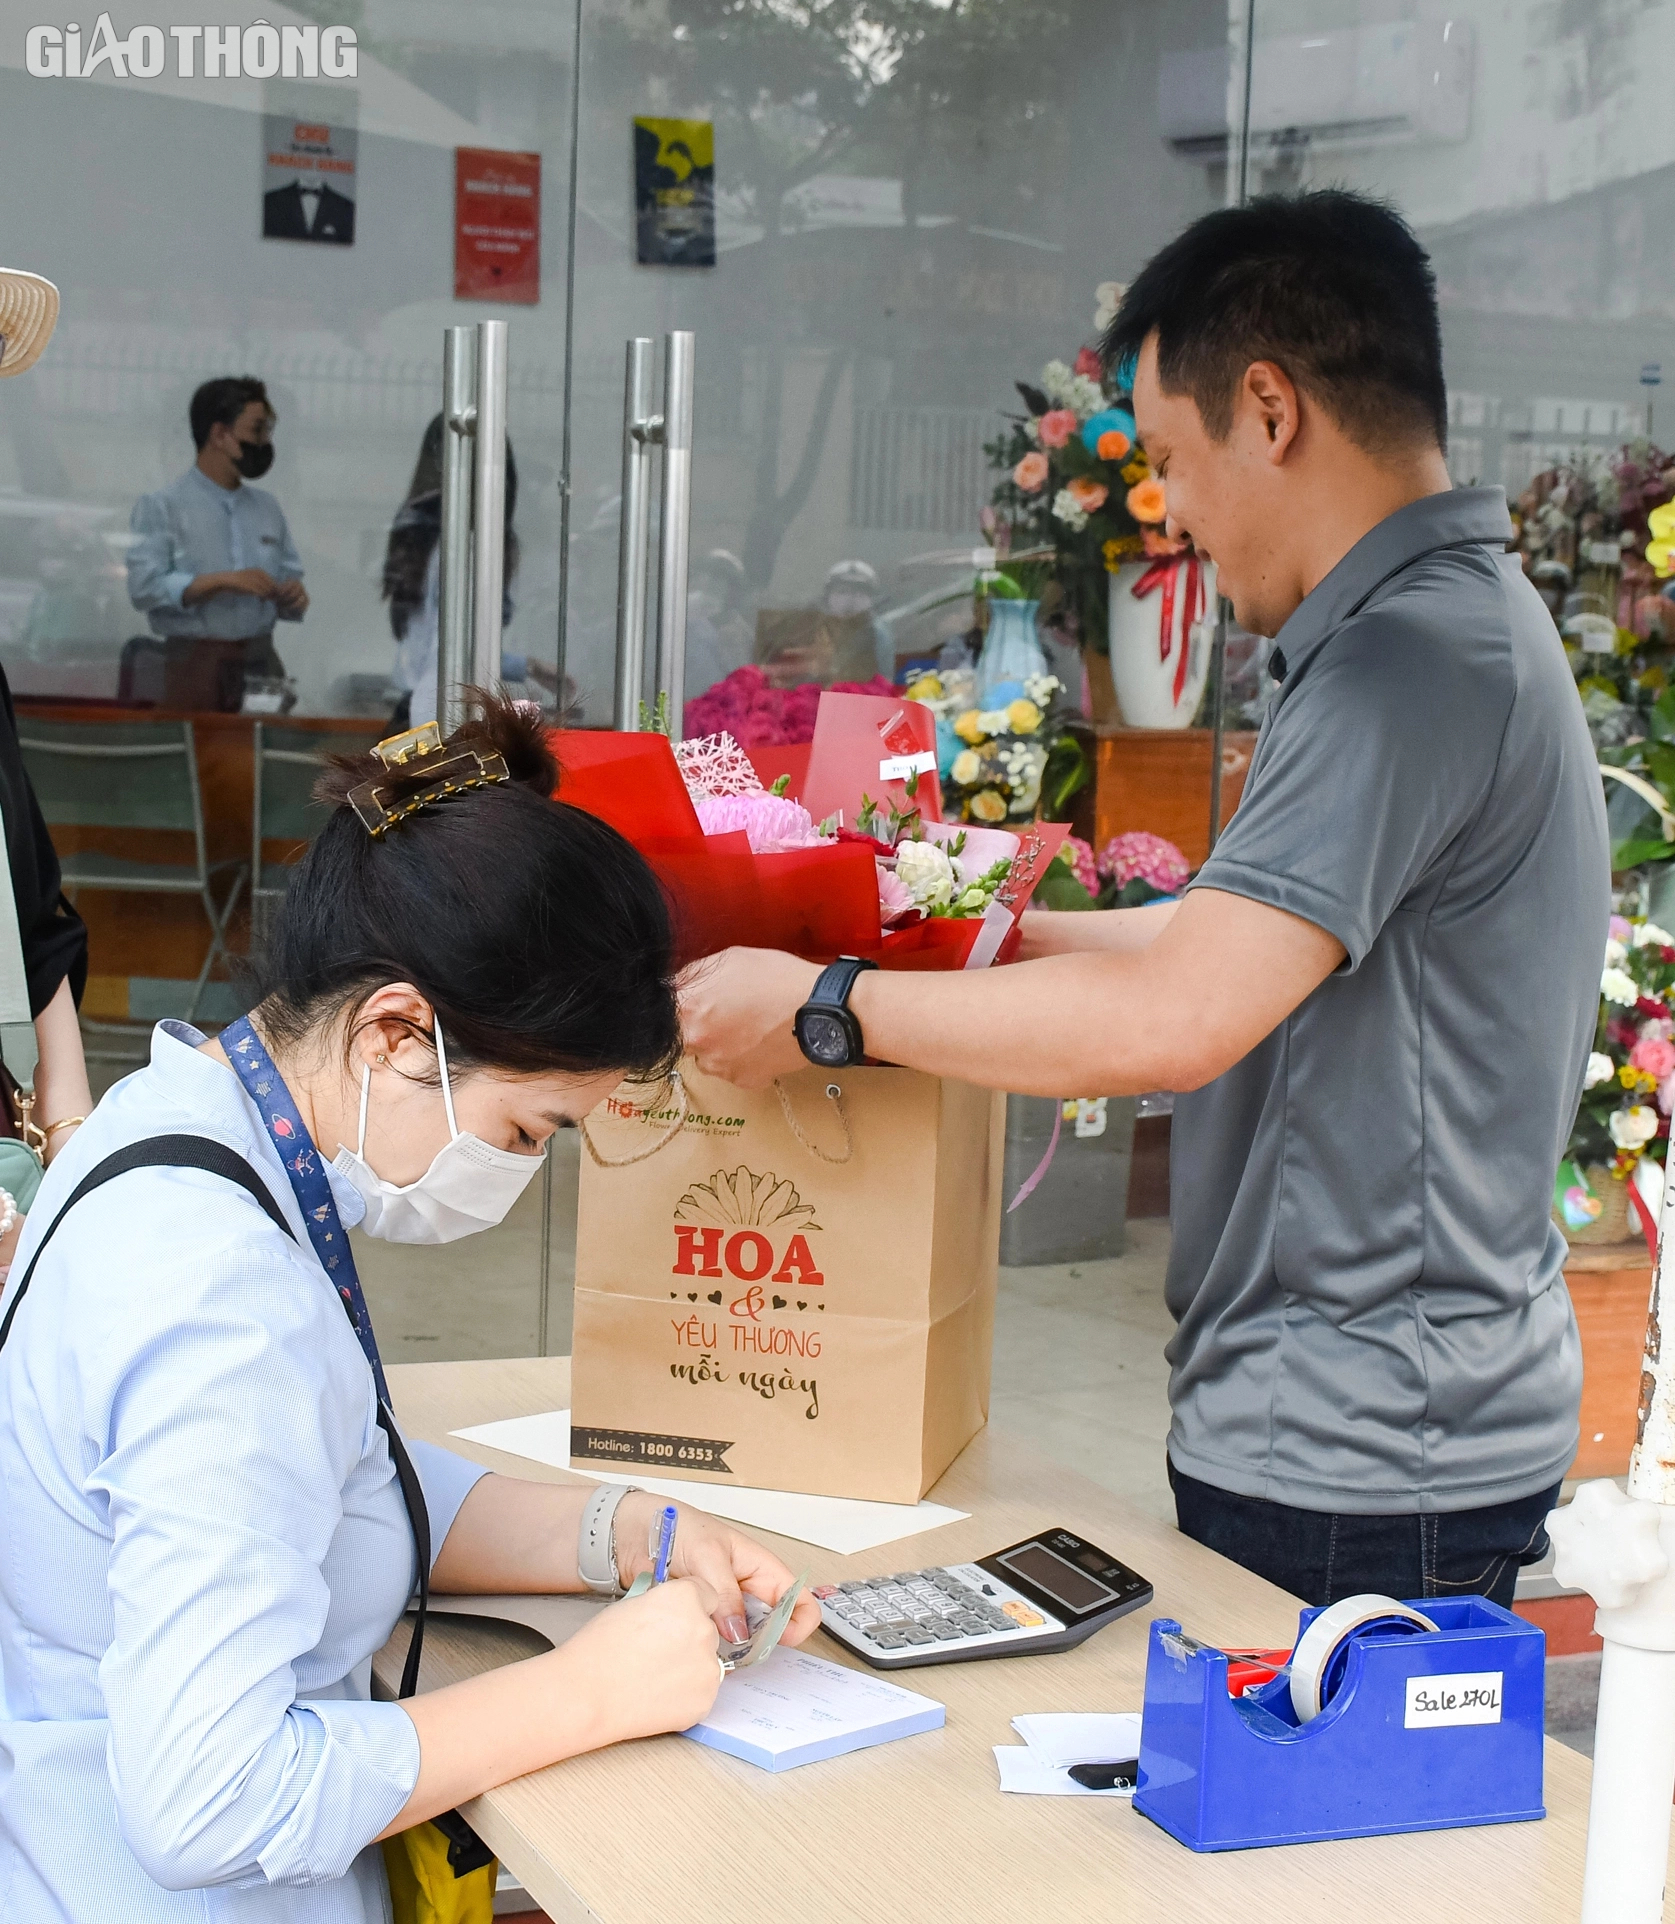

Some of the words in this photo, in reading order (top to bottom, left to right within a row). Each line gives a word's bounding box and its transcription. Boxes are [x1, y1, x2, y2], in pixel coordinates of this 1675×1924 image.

[680, 1125, 710, 1136] elivery
[713, 1127, 741, 1137] Expert
[672, 1225, 825, 1286] HOA
[729, 1285, 765, 1322] &
[671, 1313, 717, 1349] YÊU
[728, 1323, 822, 1358] THƯƠNG
[670, 1353, 731, 1385] mỗi
[738, 1367, 819, 1420] ngày
[588, 1437, 635, 1454] Hotline:
[639, 1441, 674, 1458] 1800
[678, 1447, 714, 1462] 6353
[1057, 1534, 1081, 1548] CASIO
[1415, 1691, 1457, 1712] Sale
